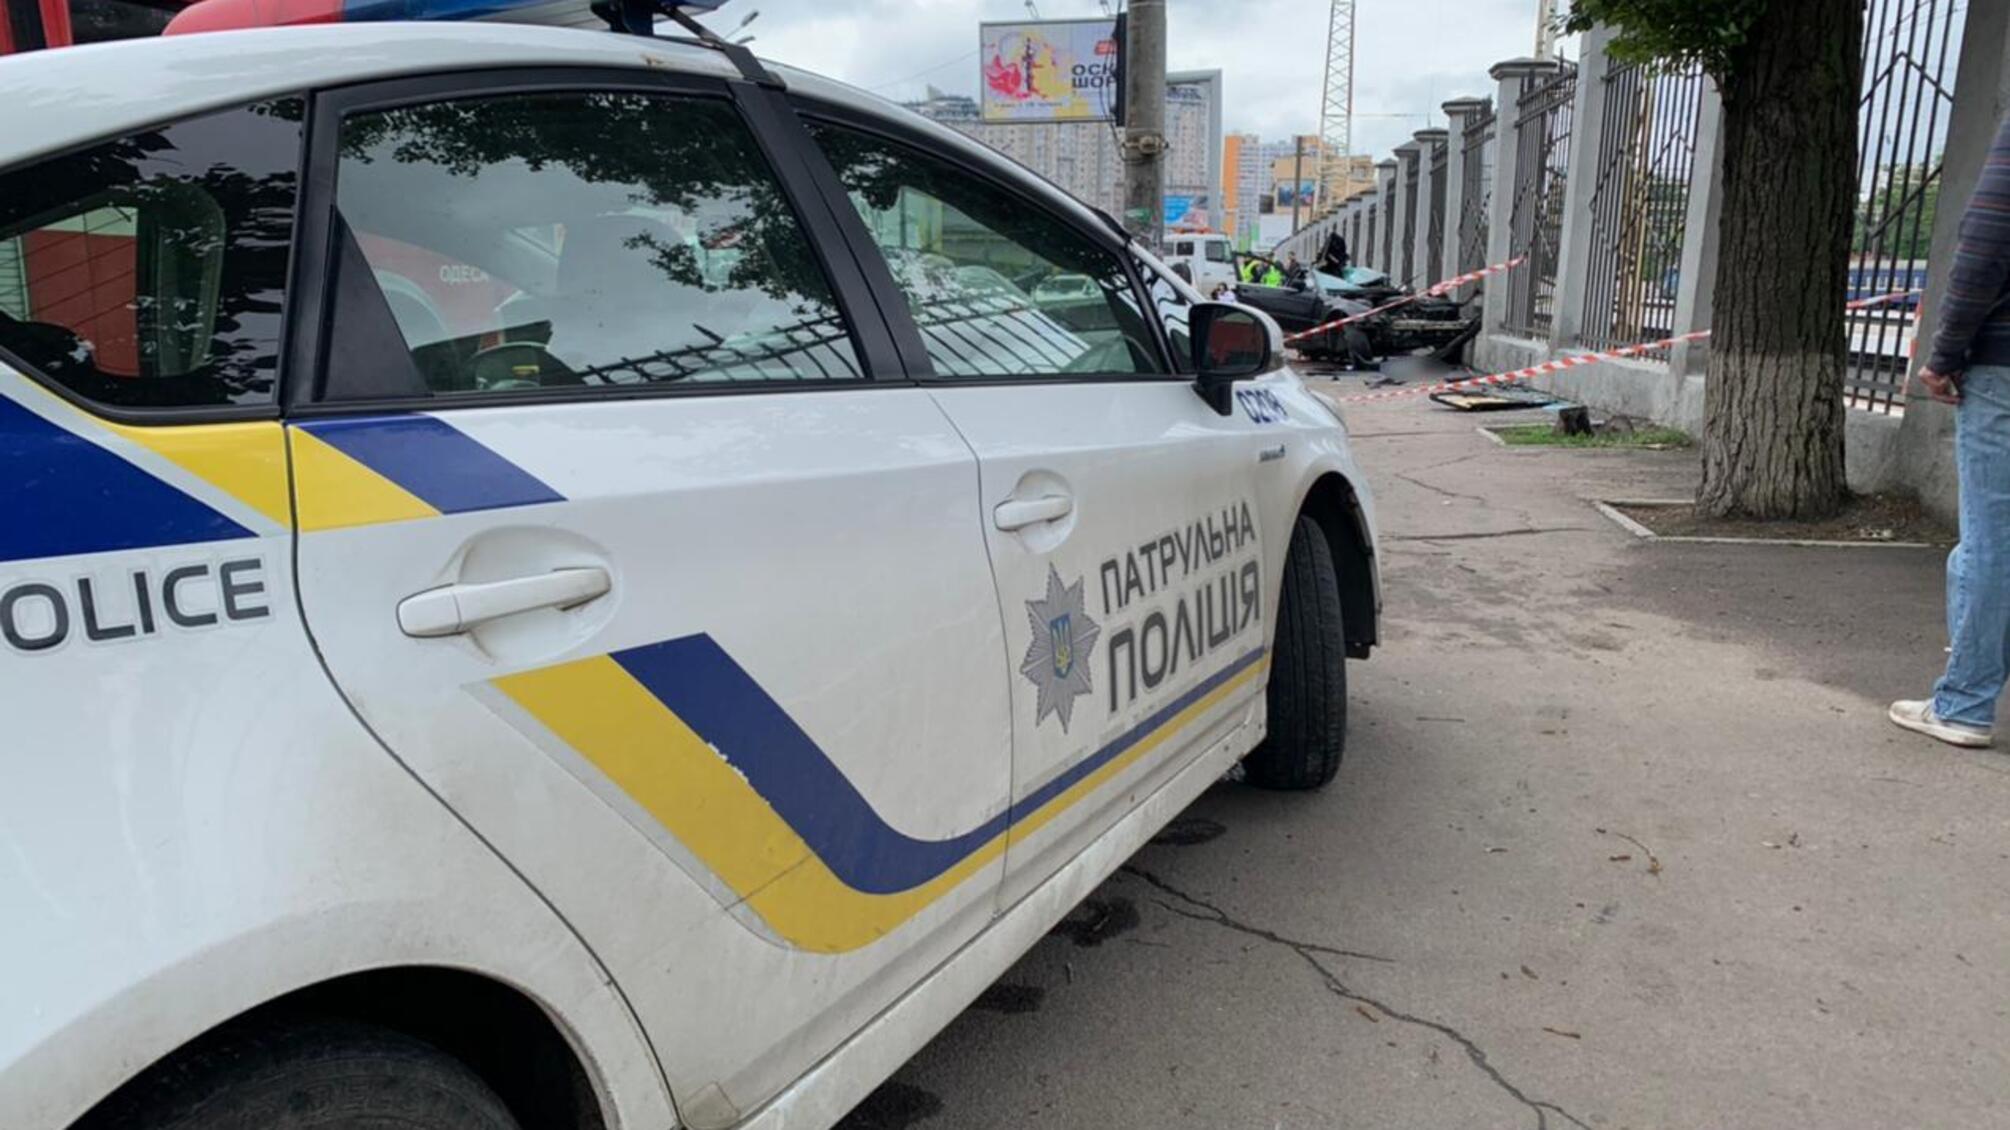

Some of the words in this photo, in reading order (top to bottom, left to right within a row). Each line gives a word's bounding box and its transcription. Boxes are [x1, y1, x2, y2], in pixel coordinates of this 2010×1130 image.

[0, 557, 270, 652] OLICE
[1101, 500, 1256, 615] ПАТРУЛЬНА
[1108, 559, 1261, 713] ПОЛІЦІЯ
